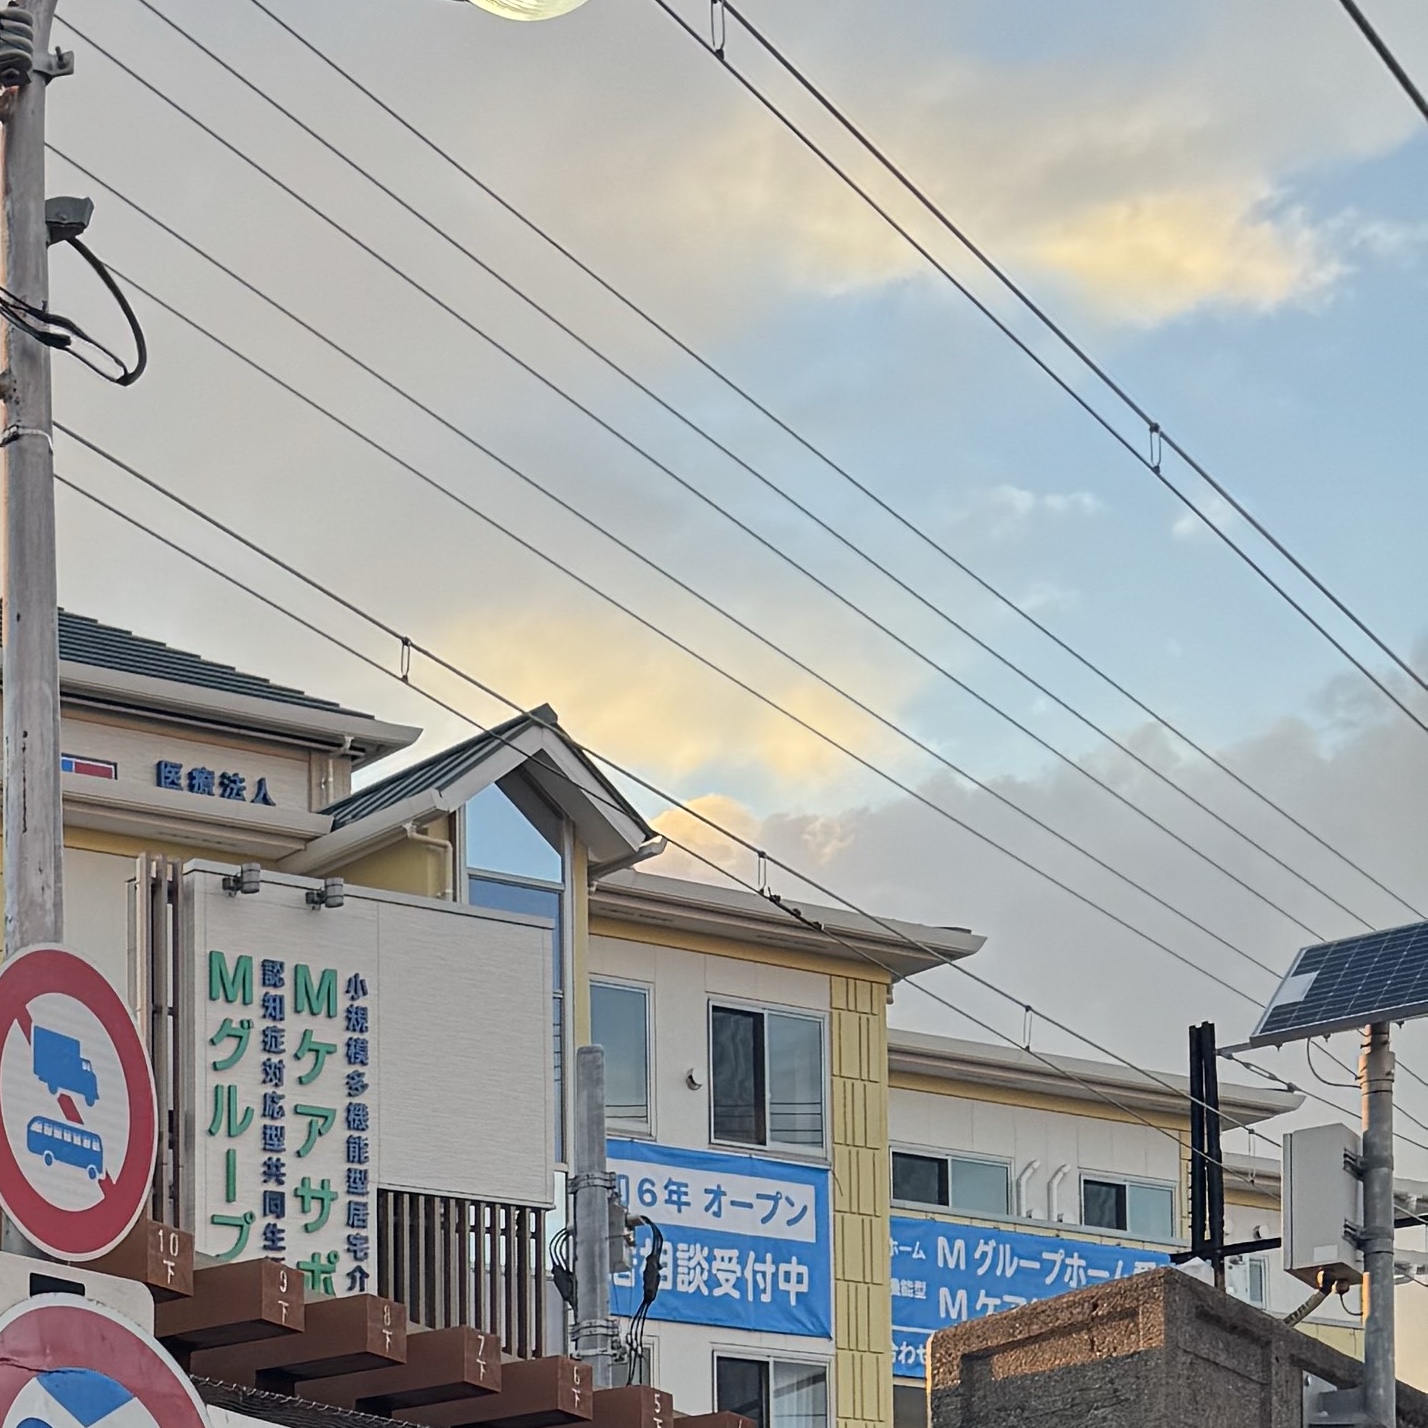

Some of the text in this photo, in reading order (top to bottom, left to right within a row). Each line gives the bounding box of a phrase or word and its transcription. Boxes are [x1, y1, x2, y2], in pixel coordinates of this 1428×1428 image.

[156, 760, 276, 806] 医療法人
[208, 950, 255, 1260] Mグループ
[260, 959, 286, 1263] 認知症対応型共同生
[345, 972, 370, 1292] 小規模多機能型居宅介
[703, 1184, 808, 1227] オープン
[157, 1227, 179, 1257] 10
[162, 1259, 175, 1285] 下
[477, 1333, 486, 1357] 7
[653, 1393, 661, 1415] 5
